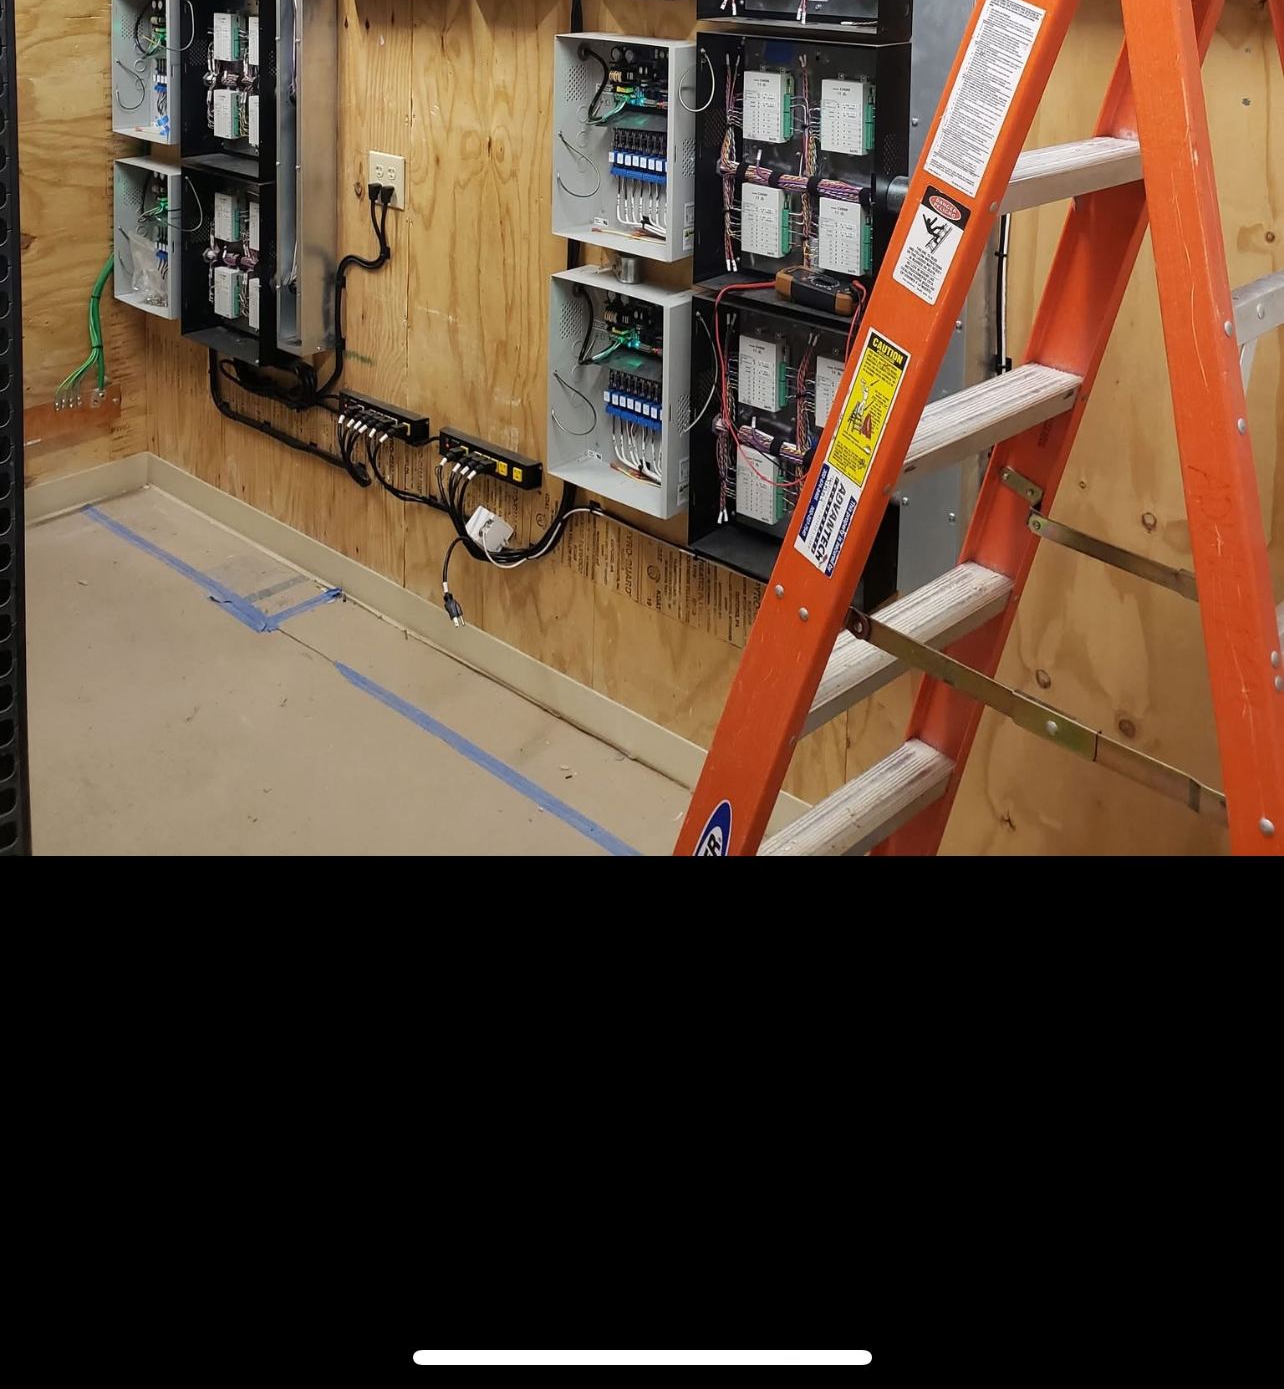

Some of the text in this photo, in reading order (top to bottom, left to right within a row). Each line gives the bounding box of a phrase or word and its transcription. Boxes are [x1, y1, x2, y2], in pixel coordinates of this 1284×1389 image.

[935, 198, 957, 213] DANGER
[872, 337, 903, 364] CAUTION
[815, 482, 847, 561] ADVANTECH
[839, 512, 851, 535] property
[830, 543, 840, 562] secured
